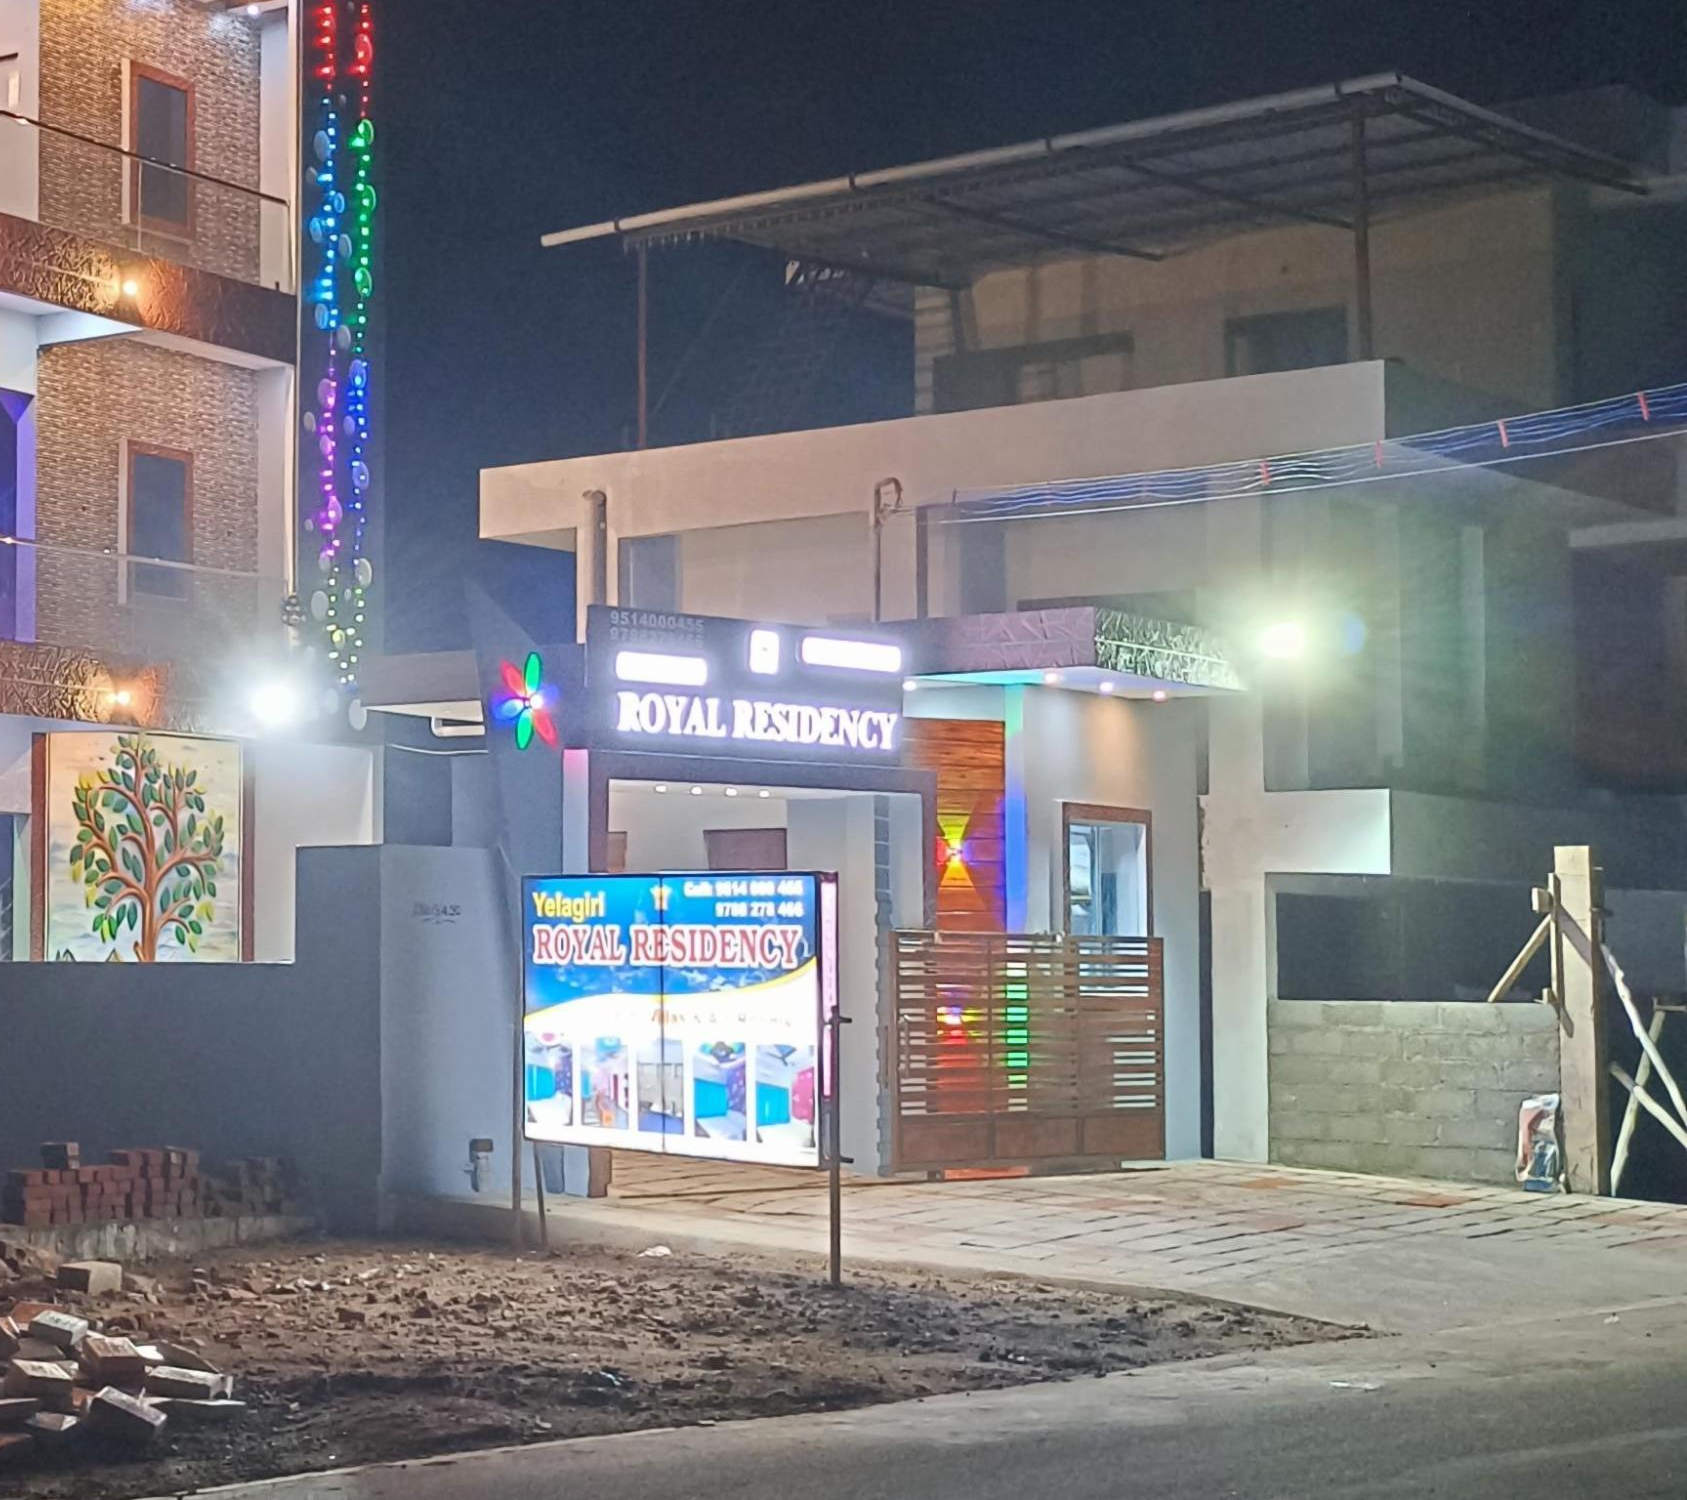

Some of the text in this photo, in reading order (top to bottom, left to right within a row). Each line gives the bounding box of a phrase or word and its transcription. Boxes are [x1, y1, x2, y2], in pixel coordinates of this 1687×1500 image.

[616, 691, 899, 750] ROYAL RESIDENCY
[531, 891, 606, 923] Yelagiri
[533, 924, 803, 968] ROYAL RESIDENCY
